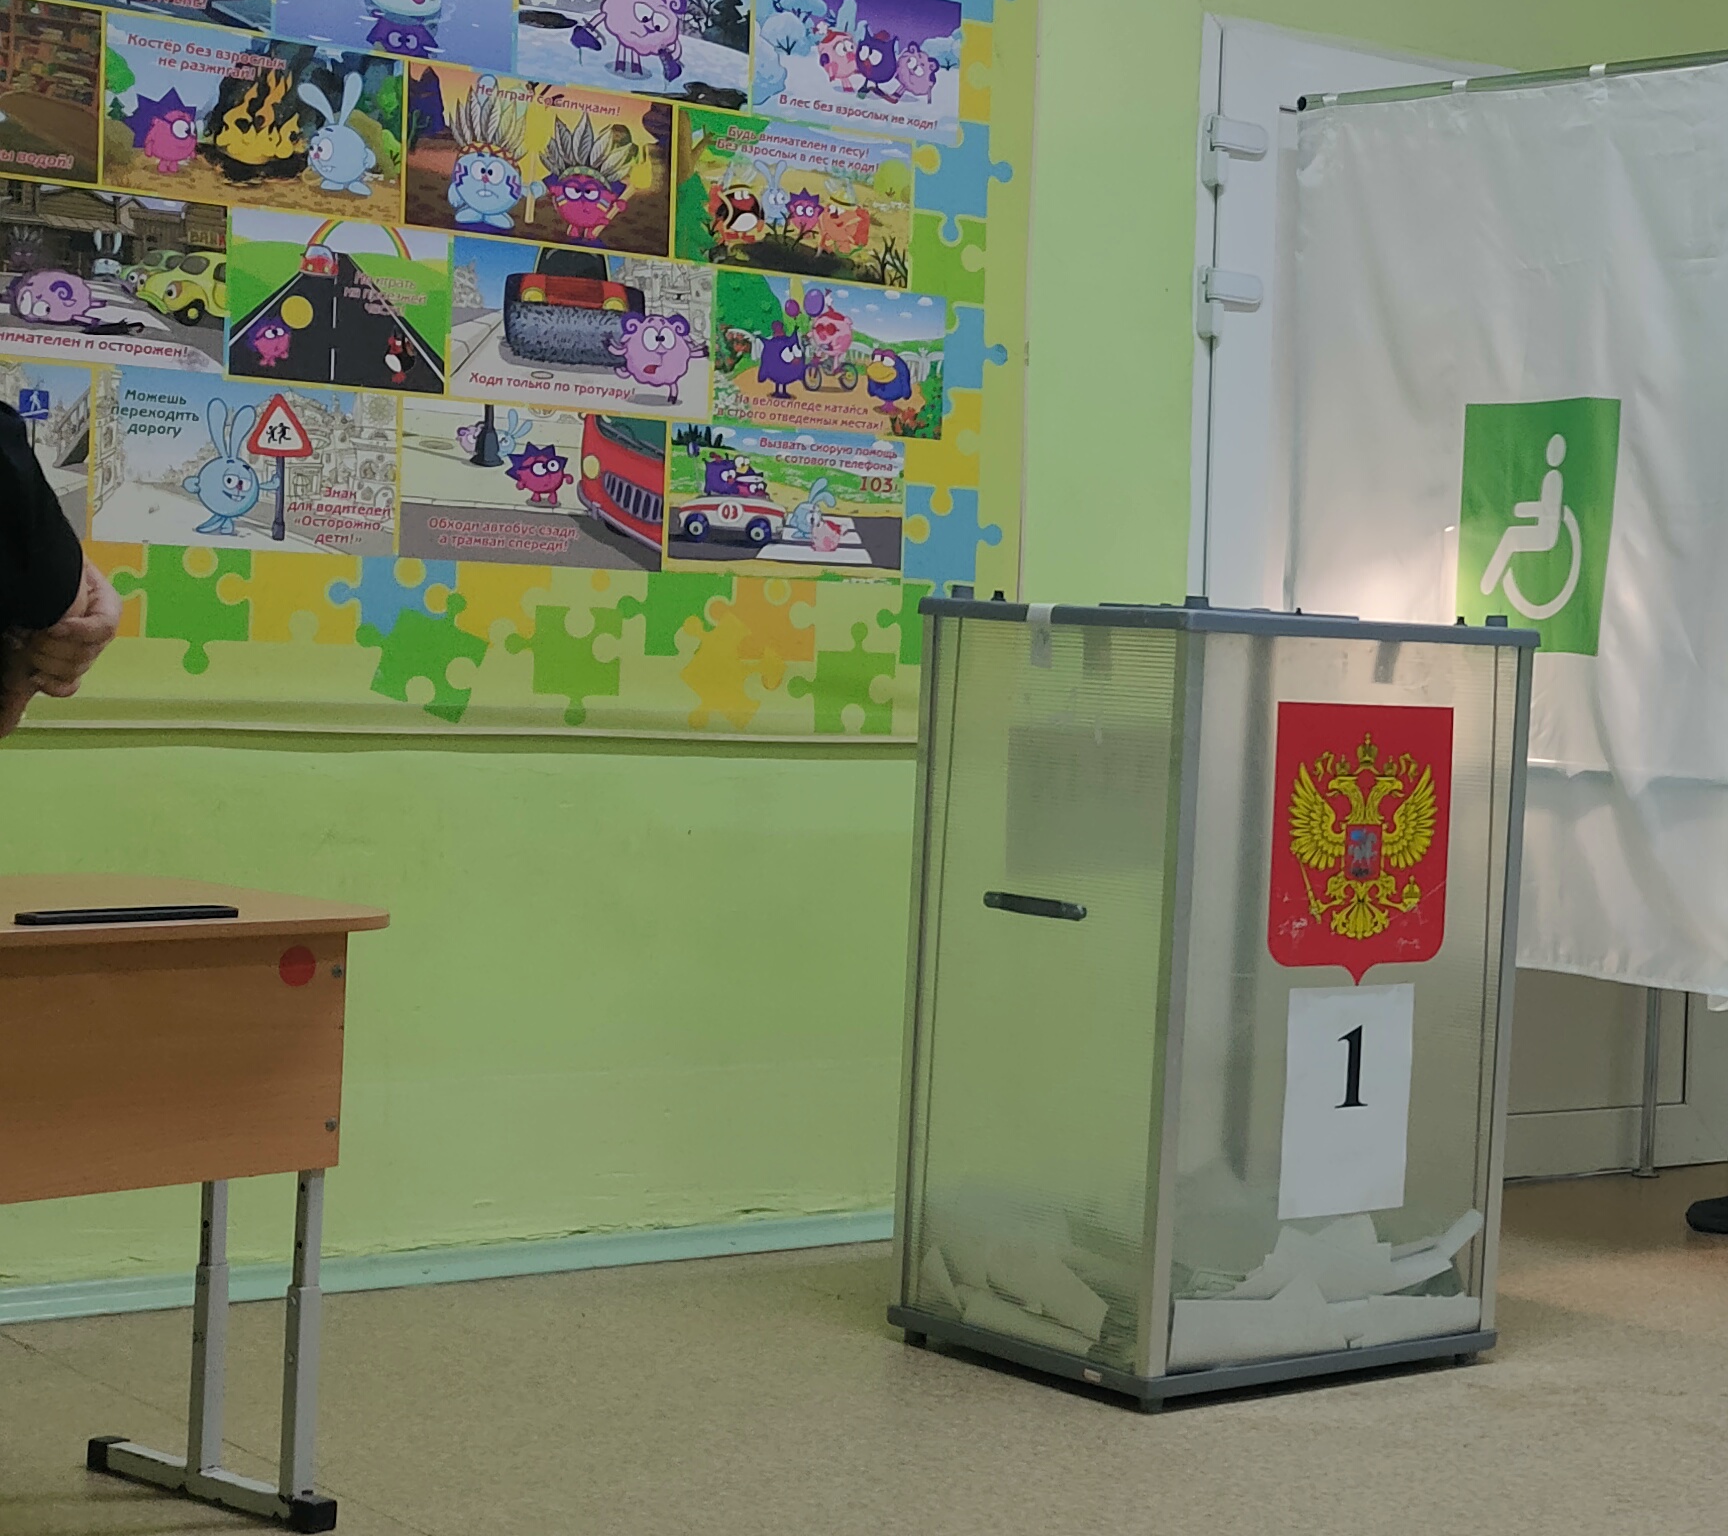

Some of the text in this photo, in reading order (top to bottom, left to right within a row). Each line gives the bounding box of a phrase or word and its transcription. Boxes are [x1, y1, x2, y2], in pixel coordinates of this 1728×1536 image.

[127, 33, 287, 70] Костёр без взрослых
[158, 56, 258, 80] не разжигай!
[475, 83, 493, 96] Не
[496, 89, 534, 103] играй
[556, 98, 621, 117] спичками!
[779, 94, 938, 130] В лес без взрослых не ходи!
[728, 126, 869, 159] Будь внимателен в лесу!
[16, 152, 74, 169] водой!
[716, 138, 879, 173] Без взрослых в лес не ходи!
[84, 339, 94, 349] и
[98, 341, 188, 358] осторожен!
[469, 372, 636, 400] Ходи только по тротуару!
[124, 389, 187, 405] Можешь
[735, 394, 869, 415] На велосипеде катайся
[110, 405, 200, 422] переходить
[717, 408, 883, 430] в строго отведенных местах!
[127, 423, 182, 438] дорогу
[760, 437, 897, 460] Вызвать скорую помощь
[775, 454, 782, 462] с
[784, 455, 837, 466] сотового
[323, 486, 357, 500] Знак
[287, 502, 391, 516] для водителей
[722, 504, 738, 520] 03
[428, 517, 479, 532] Обходи
[482, 522, 535, 536] автобус
[439, 535, 568, 552] а трамвай спереди!
[1334, 1024, 1368, 1109] 1
